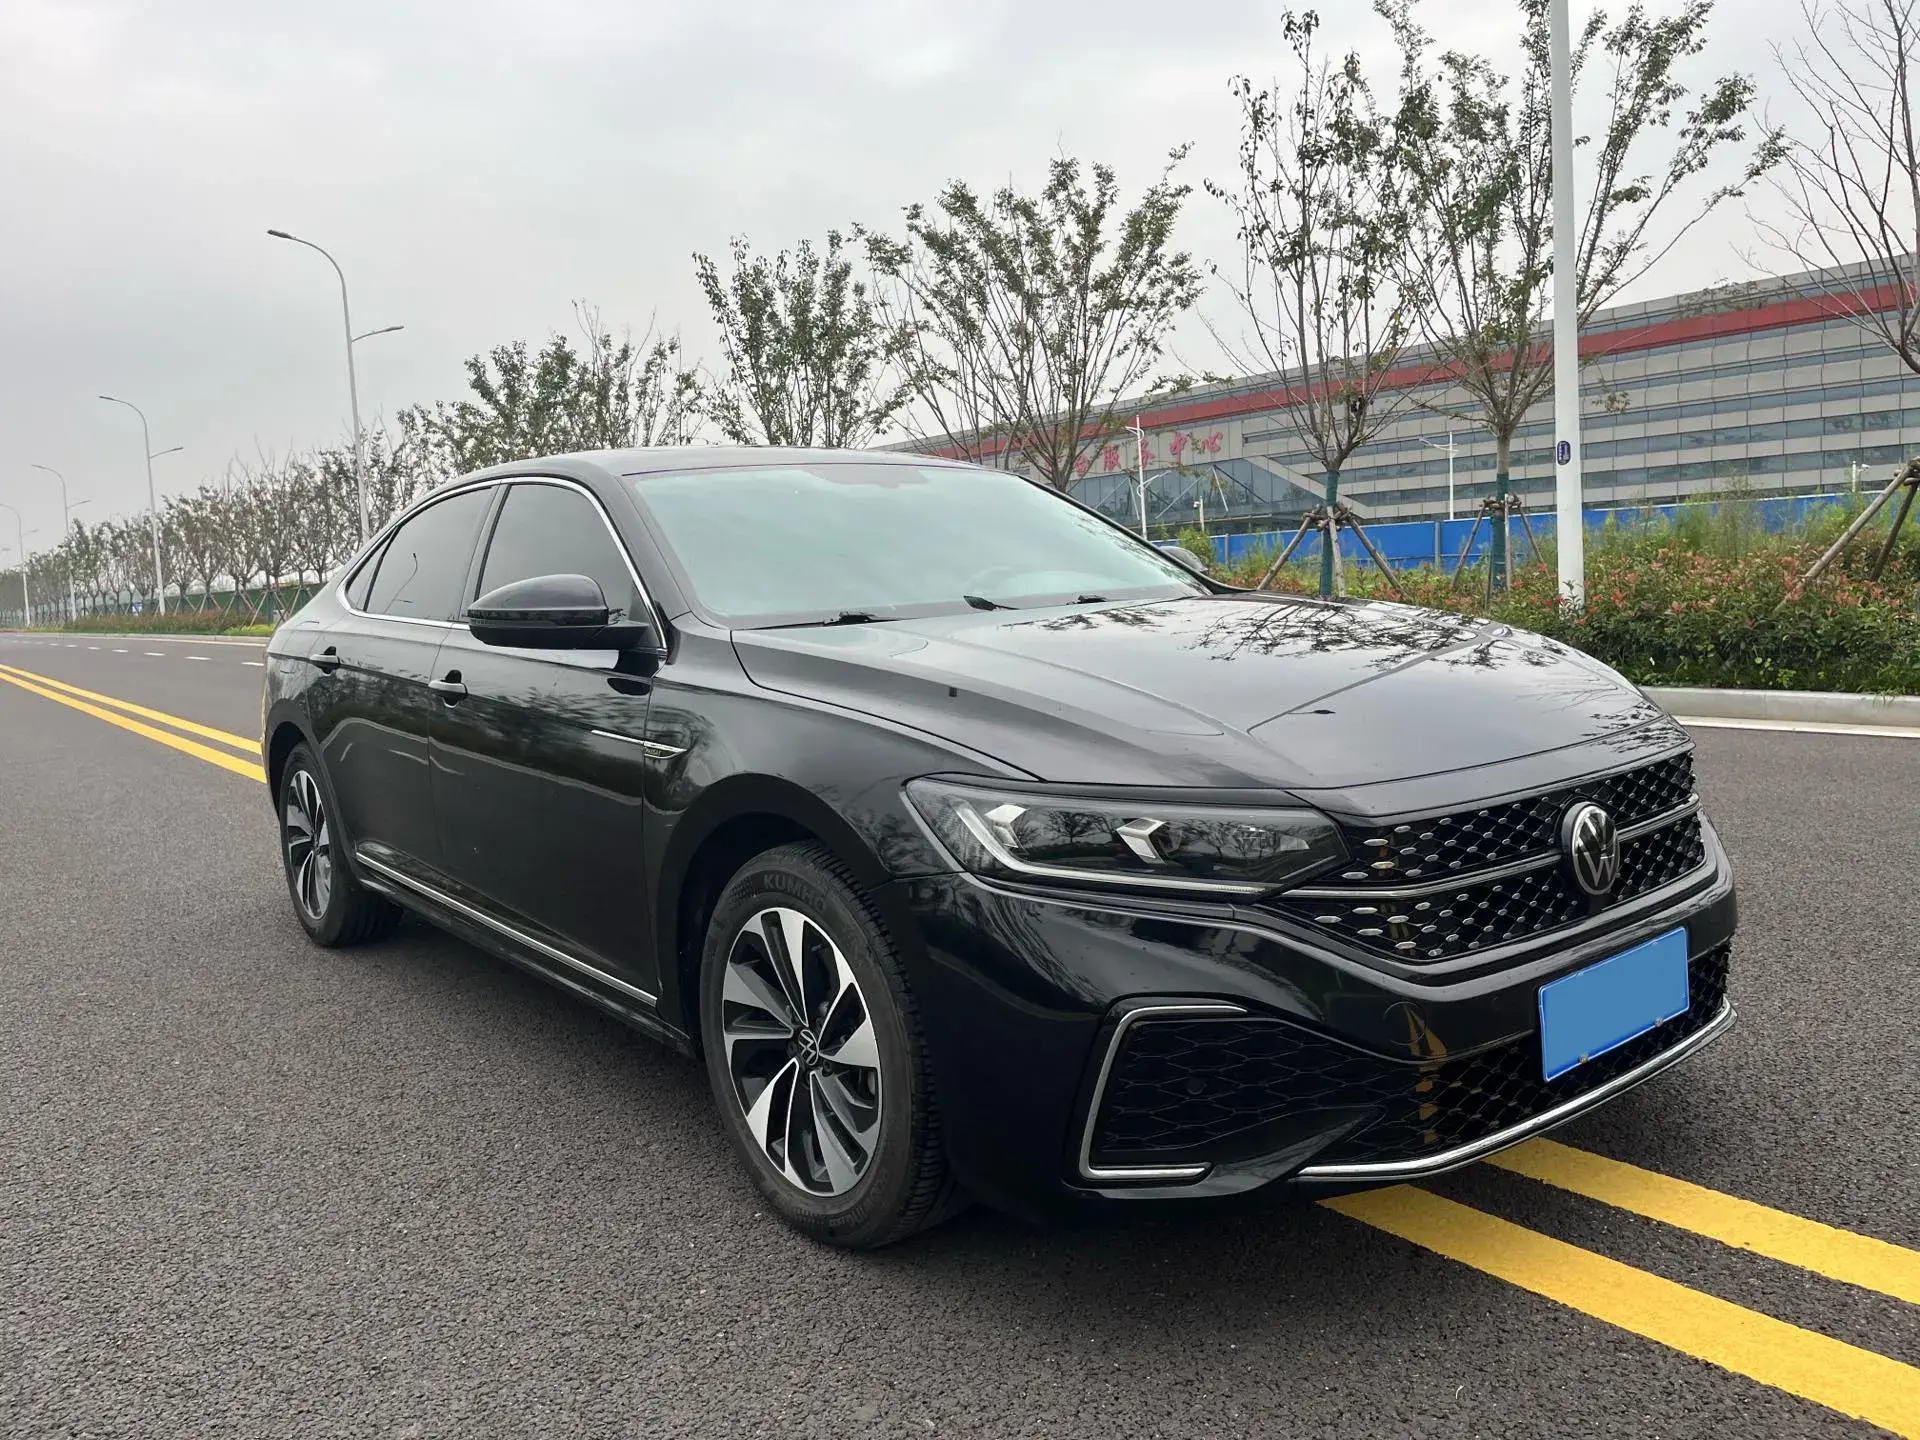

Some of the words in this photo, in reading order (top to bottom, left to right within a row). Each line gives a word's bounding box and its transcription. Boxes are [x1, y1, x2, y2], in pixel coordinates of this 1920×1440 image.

[1043, 431, 1224, 478] 合服务中心
[763, 874, 828, 911] KUMHO
